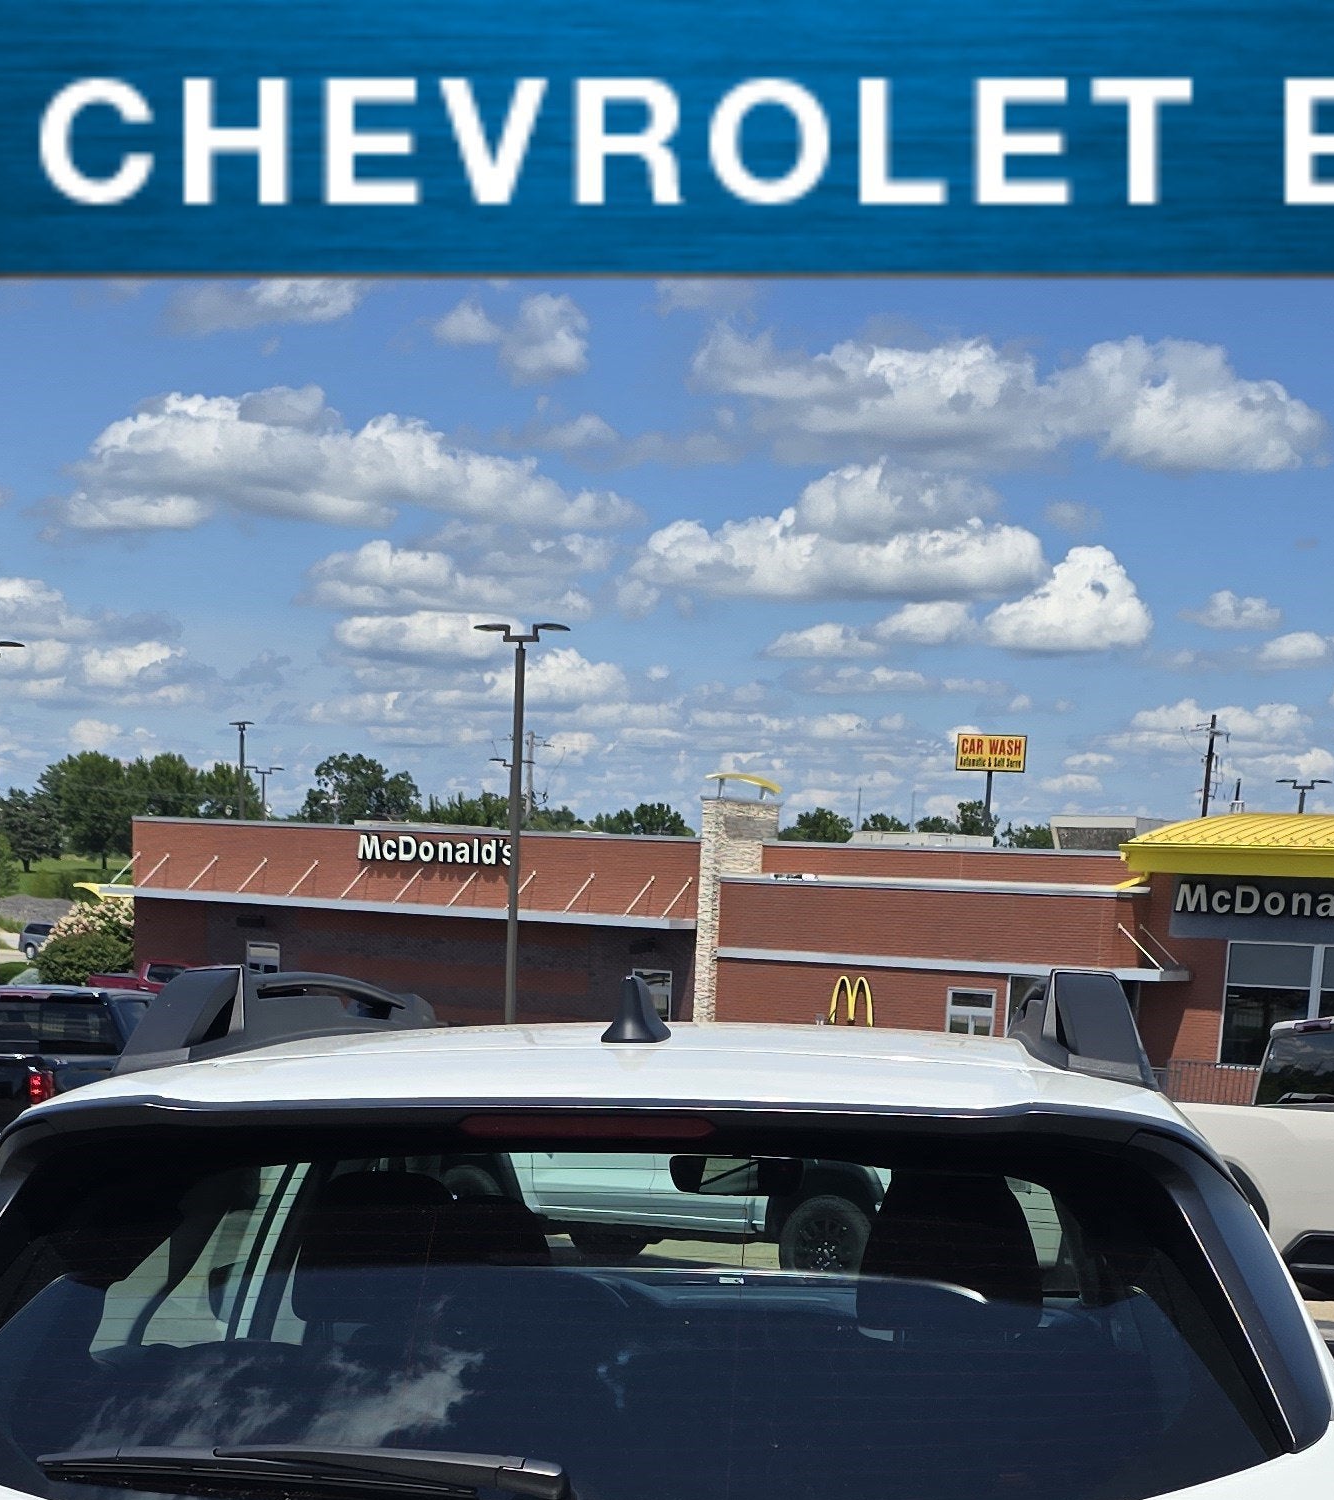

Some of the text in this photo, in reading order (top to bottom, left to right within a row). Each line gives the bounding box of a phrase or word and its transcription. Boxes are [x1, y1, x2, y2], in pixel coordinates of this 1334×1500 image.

[961, 739, 1022, 756] CAR WASH
[357, 834, 512, 866] McDonald's
